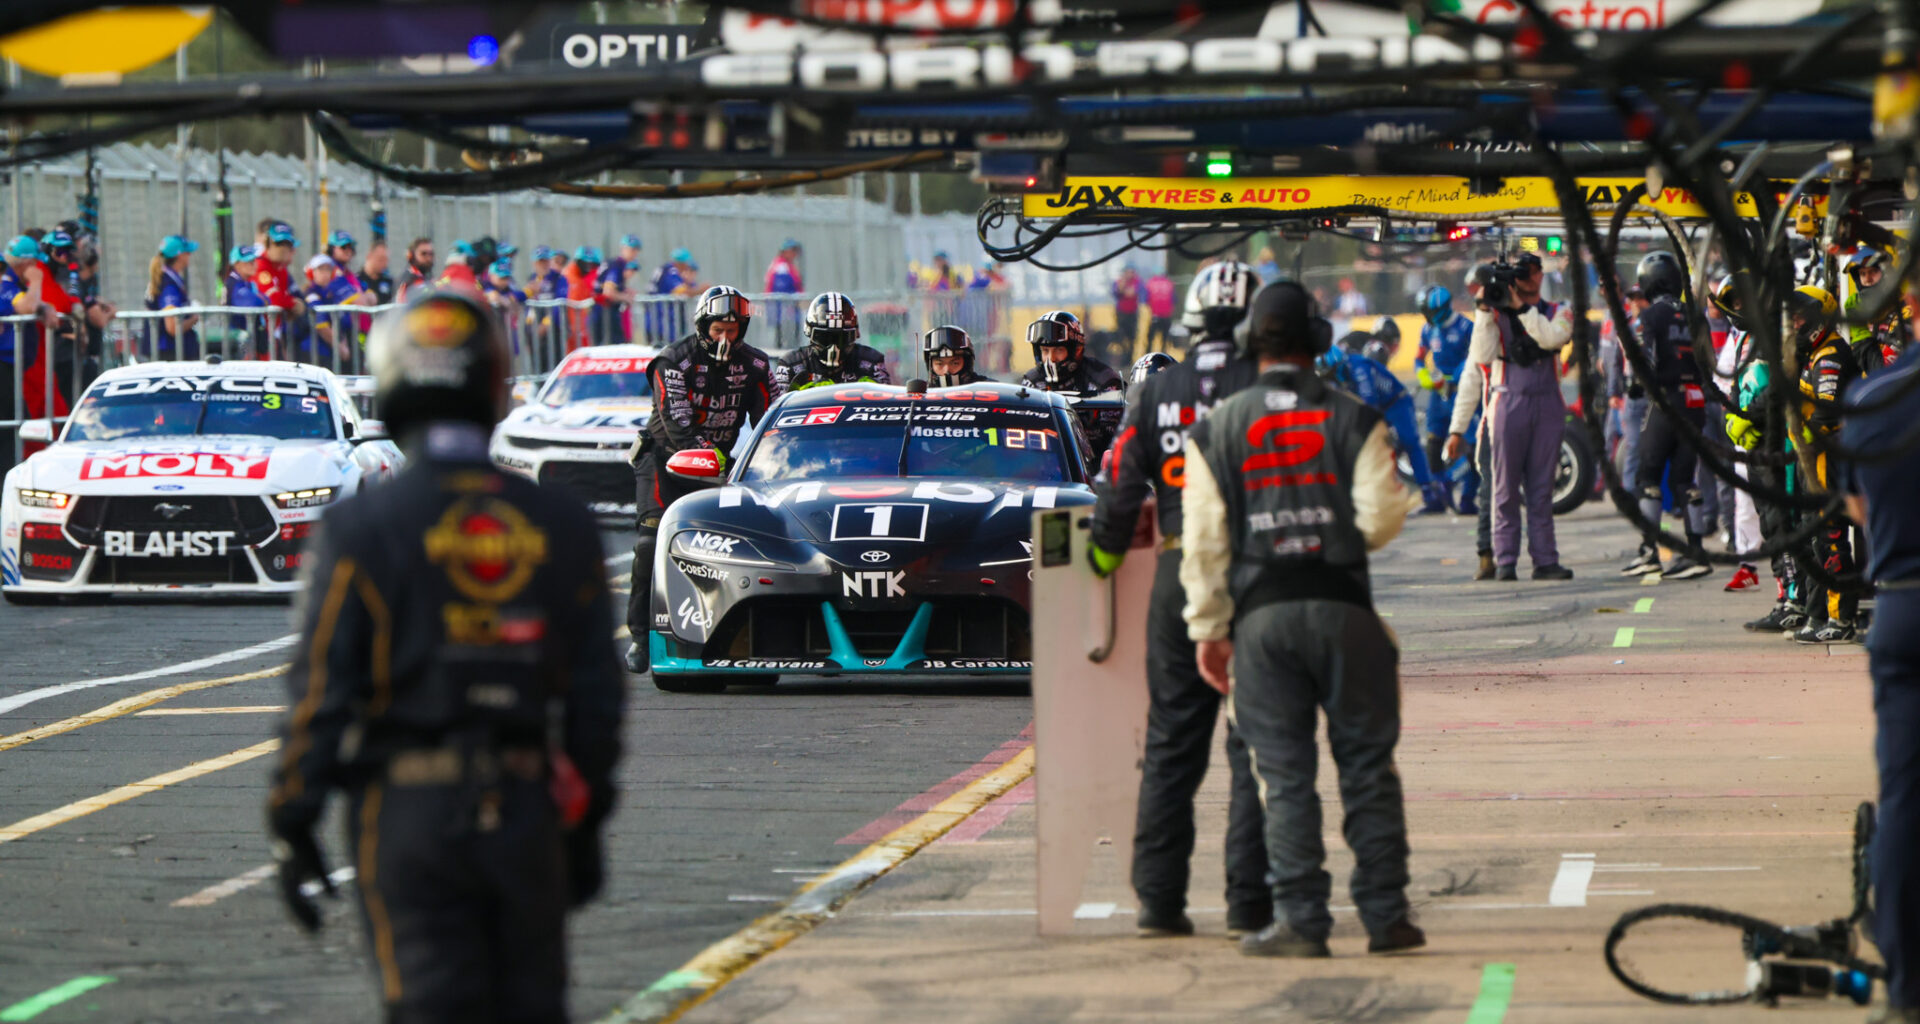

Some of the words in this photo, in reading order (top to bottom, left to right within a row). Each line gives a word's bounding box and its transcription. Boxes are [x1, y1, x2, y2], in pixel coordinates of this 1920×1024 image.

[1046, 185, 1128, 207] JAX
[1130, 188, 1216, 204] TYRES
[1220, 192, 1234, 203] &
[1240, 188, 1311, 203] AUTO
[1396, 190, 1415, 208] of
[1416, 187, 1461, 204] Mind
[1736, 193, 1750, 204] &
[664, 368, 685, 380] NTK
[103, 376, 309, 397] DAYCO
[191, 393, 261, 403] Cameron
[262, 394, 281, 410] 3
[301, 397, 318, 414] 5
[692, 393, 726, 409] Mobil
[777, 413, 838, 426] GR
[845, 412, 976, 421] Australia
[992, 408, 1050, 418] Racing
[910, 426, 980, 438] Mostert
[983, 428, 998, 446] 1
[1006, 428, 1047, 450] 27
[88, 454, 267, 479] MOLY
[692, 456, 715, 469] BOC
[718, 480, 1058, 510] Mobil
[863, 505, 893, 537] 1
[104, 530, 236, 557] BLAHST
[690, 531, 740, 553] NGK
[32, 552, 72, 570] BOSCH
[842, 570, 906, 598] NTK
[677, 597, 714, 630] yes
[733, 659, 825, 668] Caravans
[923, 660, 946, 668] JB
[950, 659, 1033, 668] Caravan
